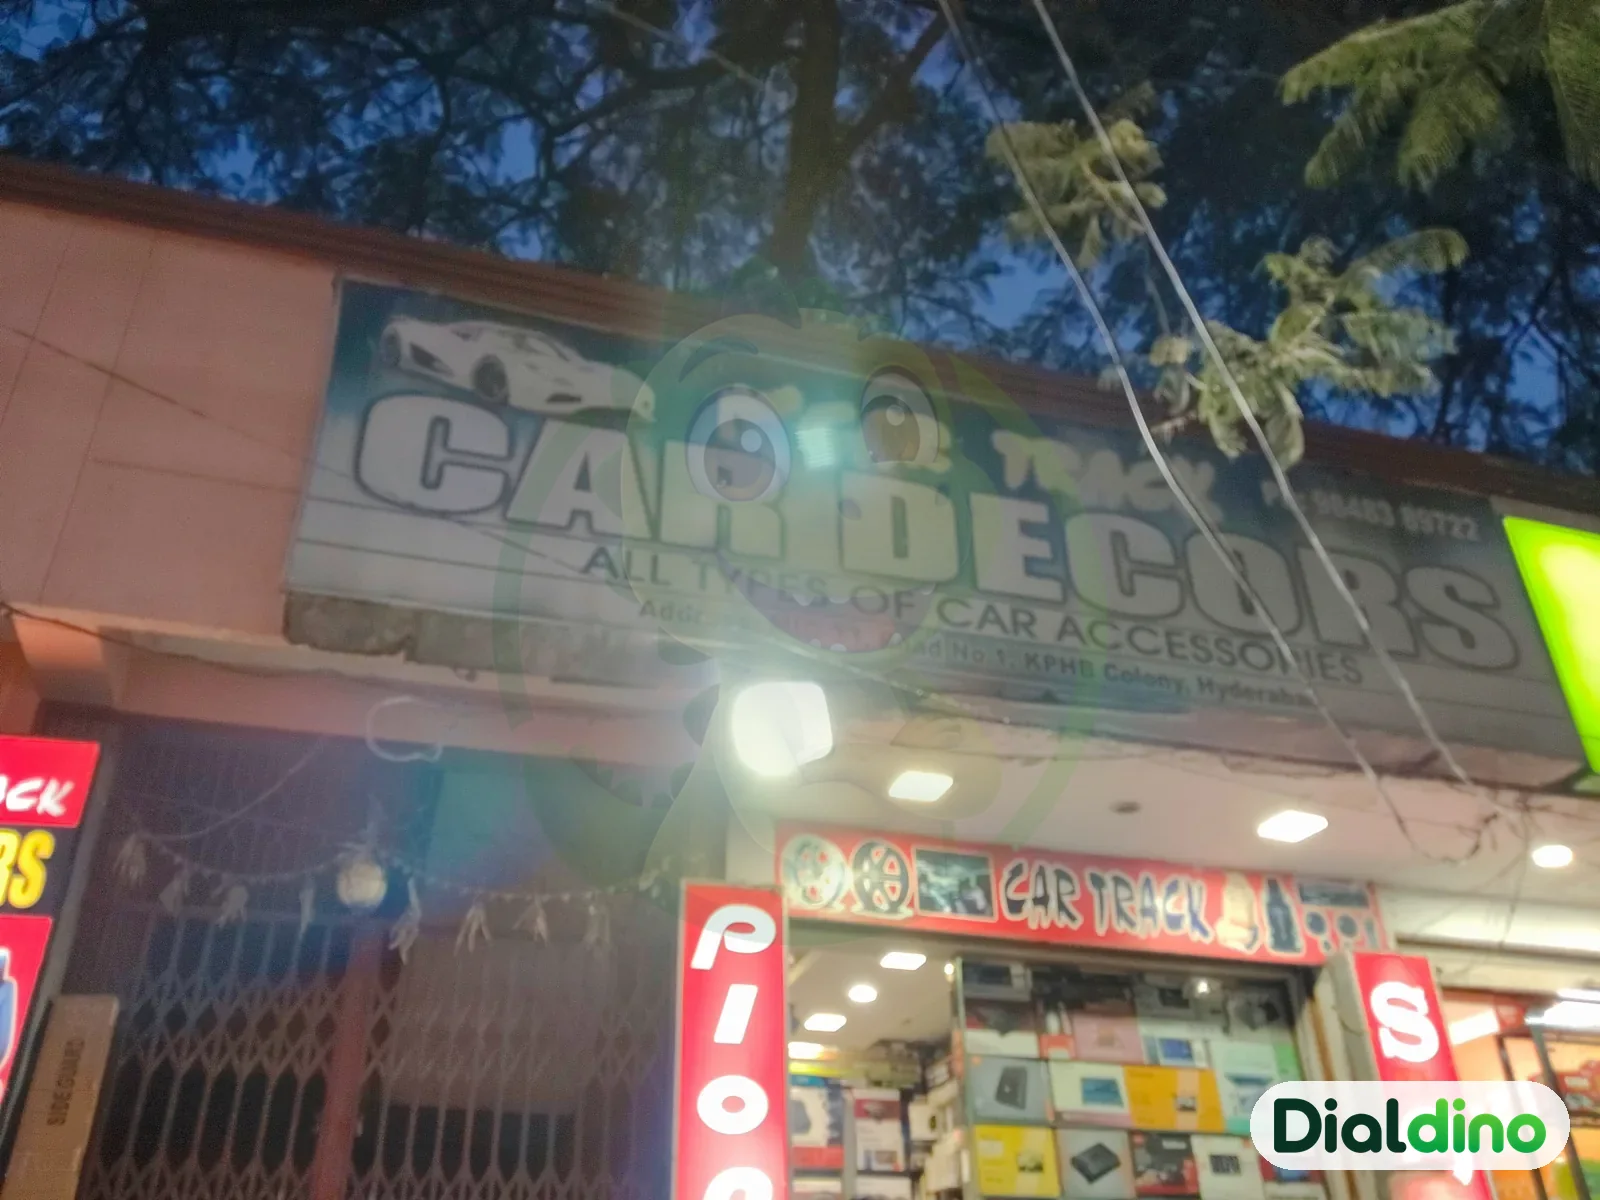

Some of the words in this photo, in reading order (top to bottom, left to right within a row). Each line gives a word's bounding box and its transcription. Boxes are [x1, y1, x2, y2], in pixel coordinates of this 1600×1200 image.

[356, 391, 786, 557] CAR
[842, 467, 1520, 672] DECORS
[582, 544, 674, 588] ALL
[690, 557, 834, 609] TYPES
[848, 583, 917, 620] OF
[936, 599, 1038, 640] CAR
[1055, 614, 1364, 688] ACCESSORIES
[1003, 860, 1082, 930] CAR
[1088, 867, 1214, 941] TRACK
